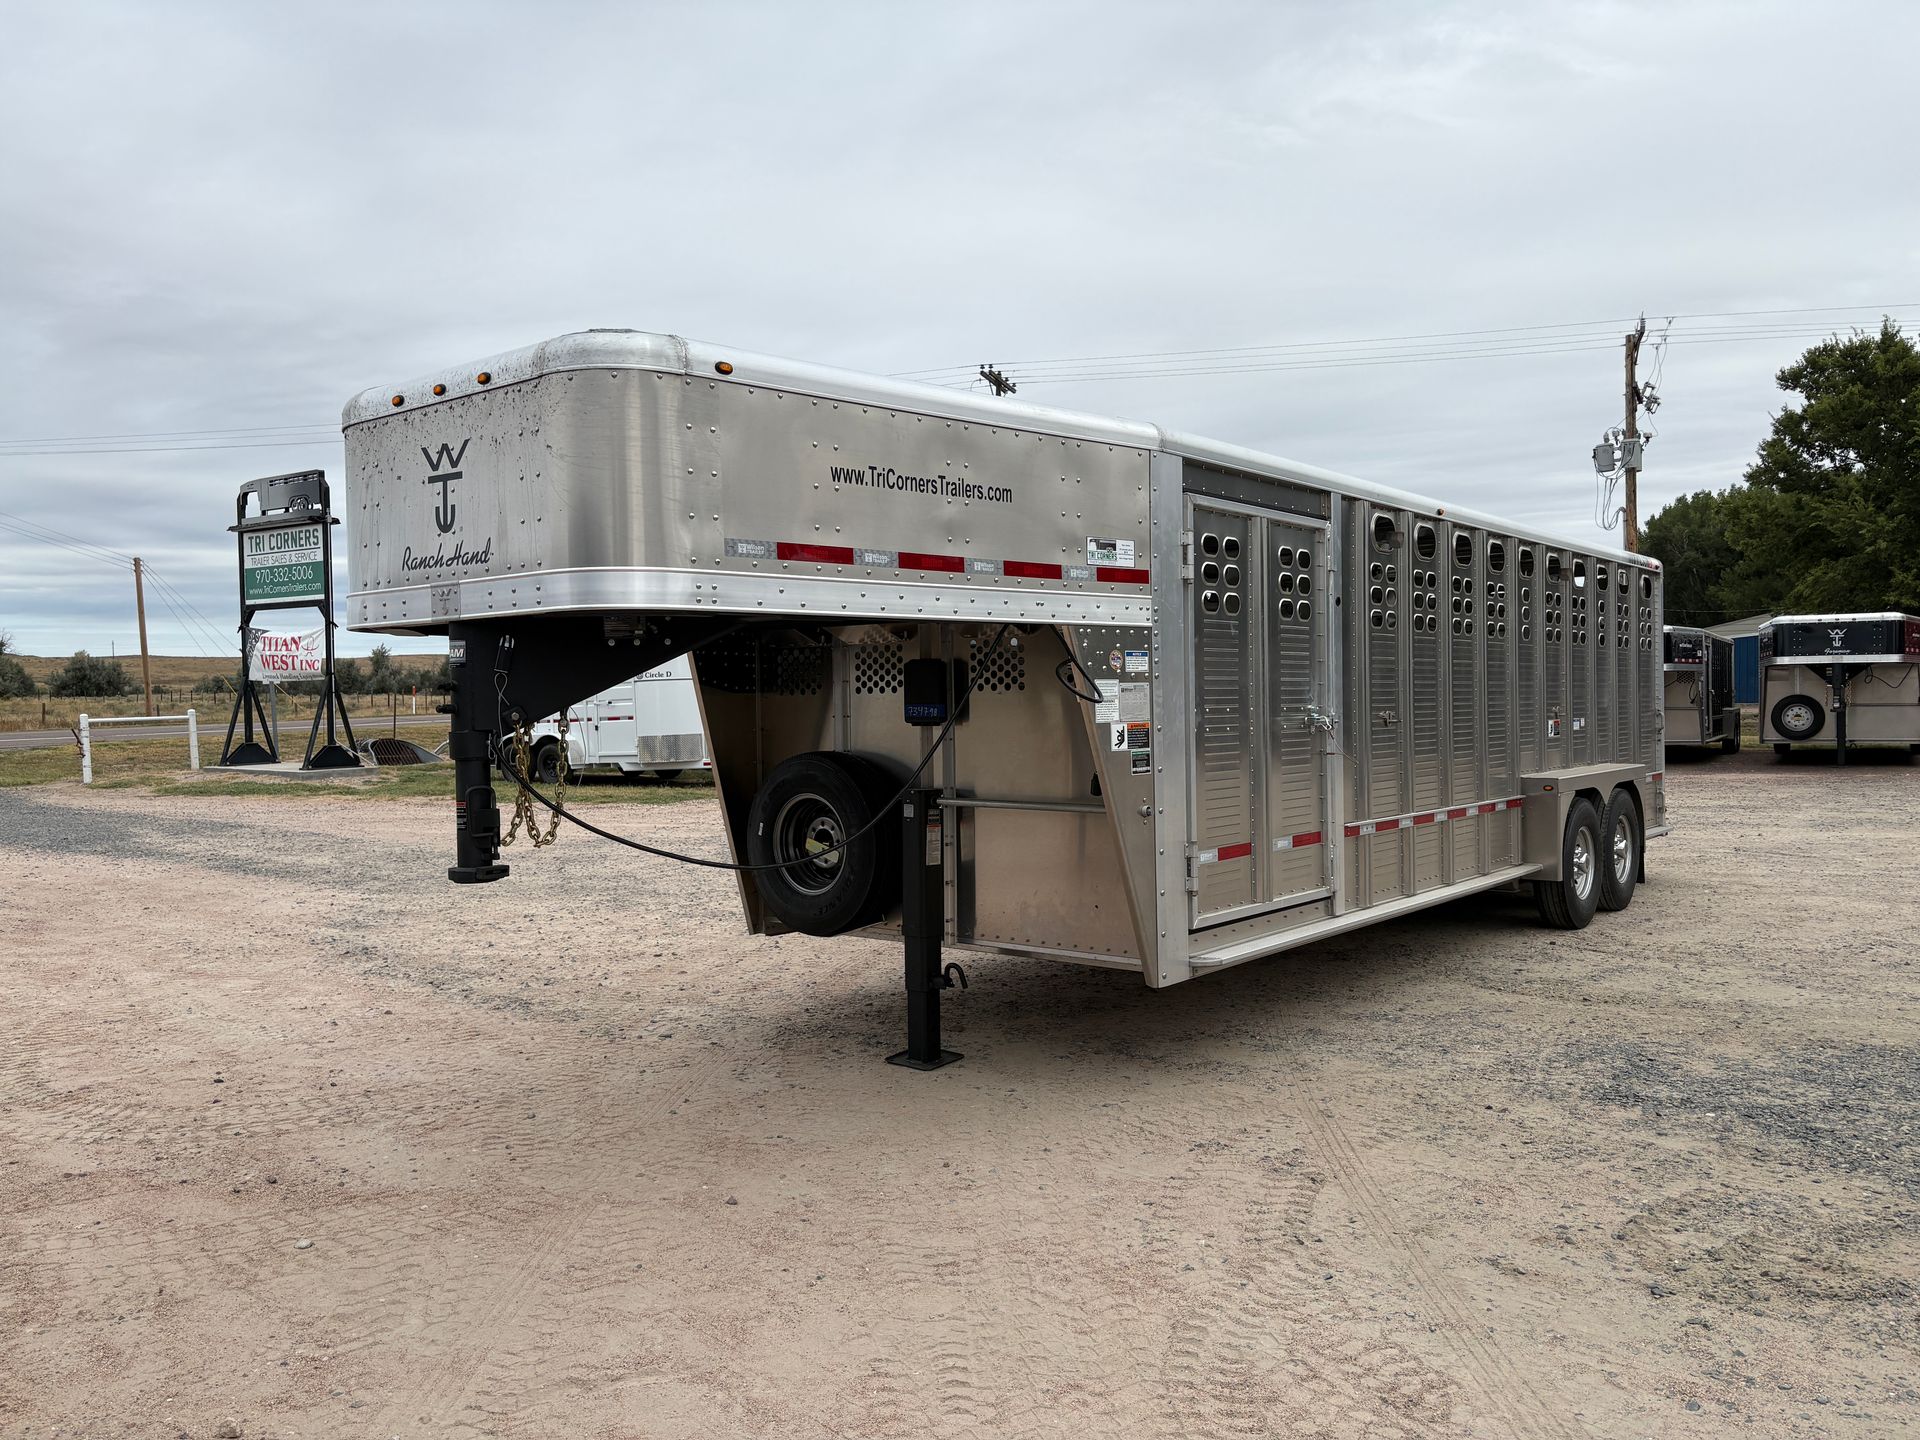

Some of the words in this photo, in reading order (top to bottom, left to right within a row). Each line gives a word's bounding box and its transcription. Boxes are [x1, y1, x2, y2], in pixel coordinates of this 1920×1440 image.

[830, 465, 1013, 503] www.TriCornersTrailers.com
[248, 534, 265, 553] TRI
[268, 528, 319, 551] CORNERS
[251, 555, 270, 566] TRAILER
[271, 554, 287, 565] SALES
[288, 553, 293, 563] &
[294, 551, 317, 562] SERVICE
[402, 542, 444, 571] Ranch
[445, 537, 491, 567] Hand
[255, 565, 314, 584] 970-332-5006
[260, 636, 302, 652] TITAN
[449, 648, 465, 658] AM
[260, 654, 299, 671] WEST
[300, 659, 320, 671] INC
[644, 671, 665, 679] Circle
[666, 670, 672, 678] D
